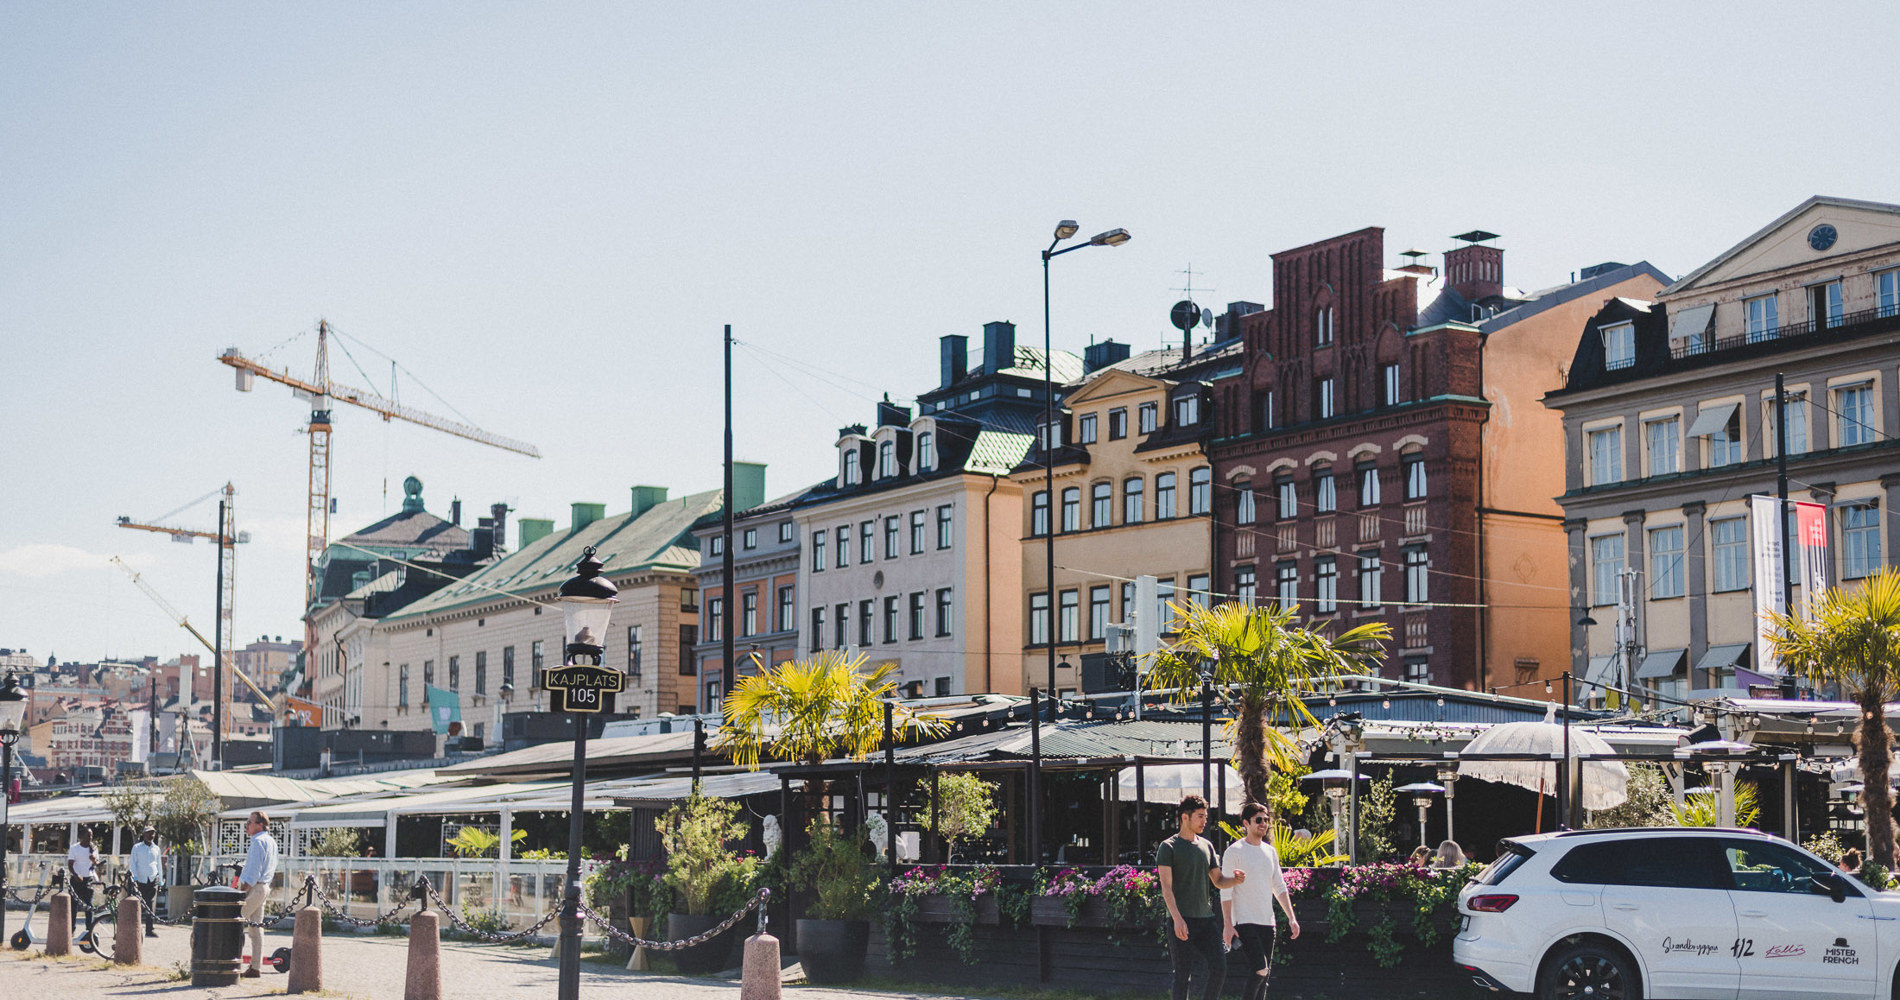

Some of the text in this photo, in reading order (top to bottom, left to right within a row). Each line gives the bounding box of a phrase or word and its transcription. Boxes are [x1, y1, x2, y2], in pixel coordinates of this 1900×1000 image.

[550, 672, 617, 687] KAJPLATS
[571, 688, 596, 703] 105
[1825, 948, 1856, 957] MISTER
[1823, 956, 1859, 965] FRENCH
